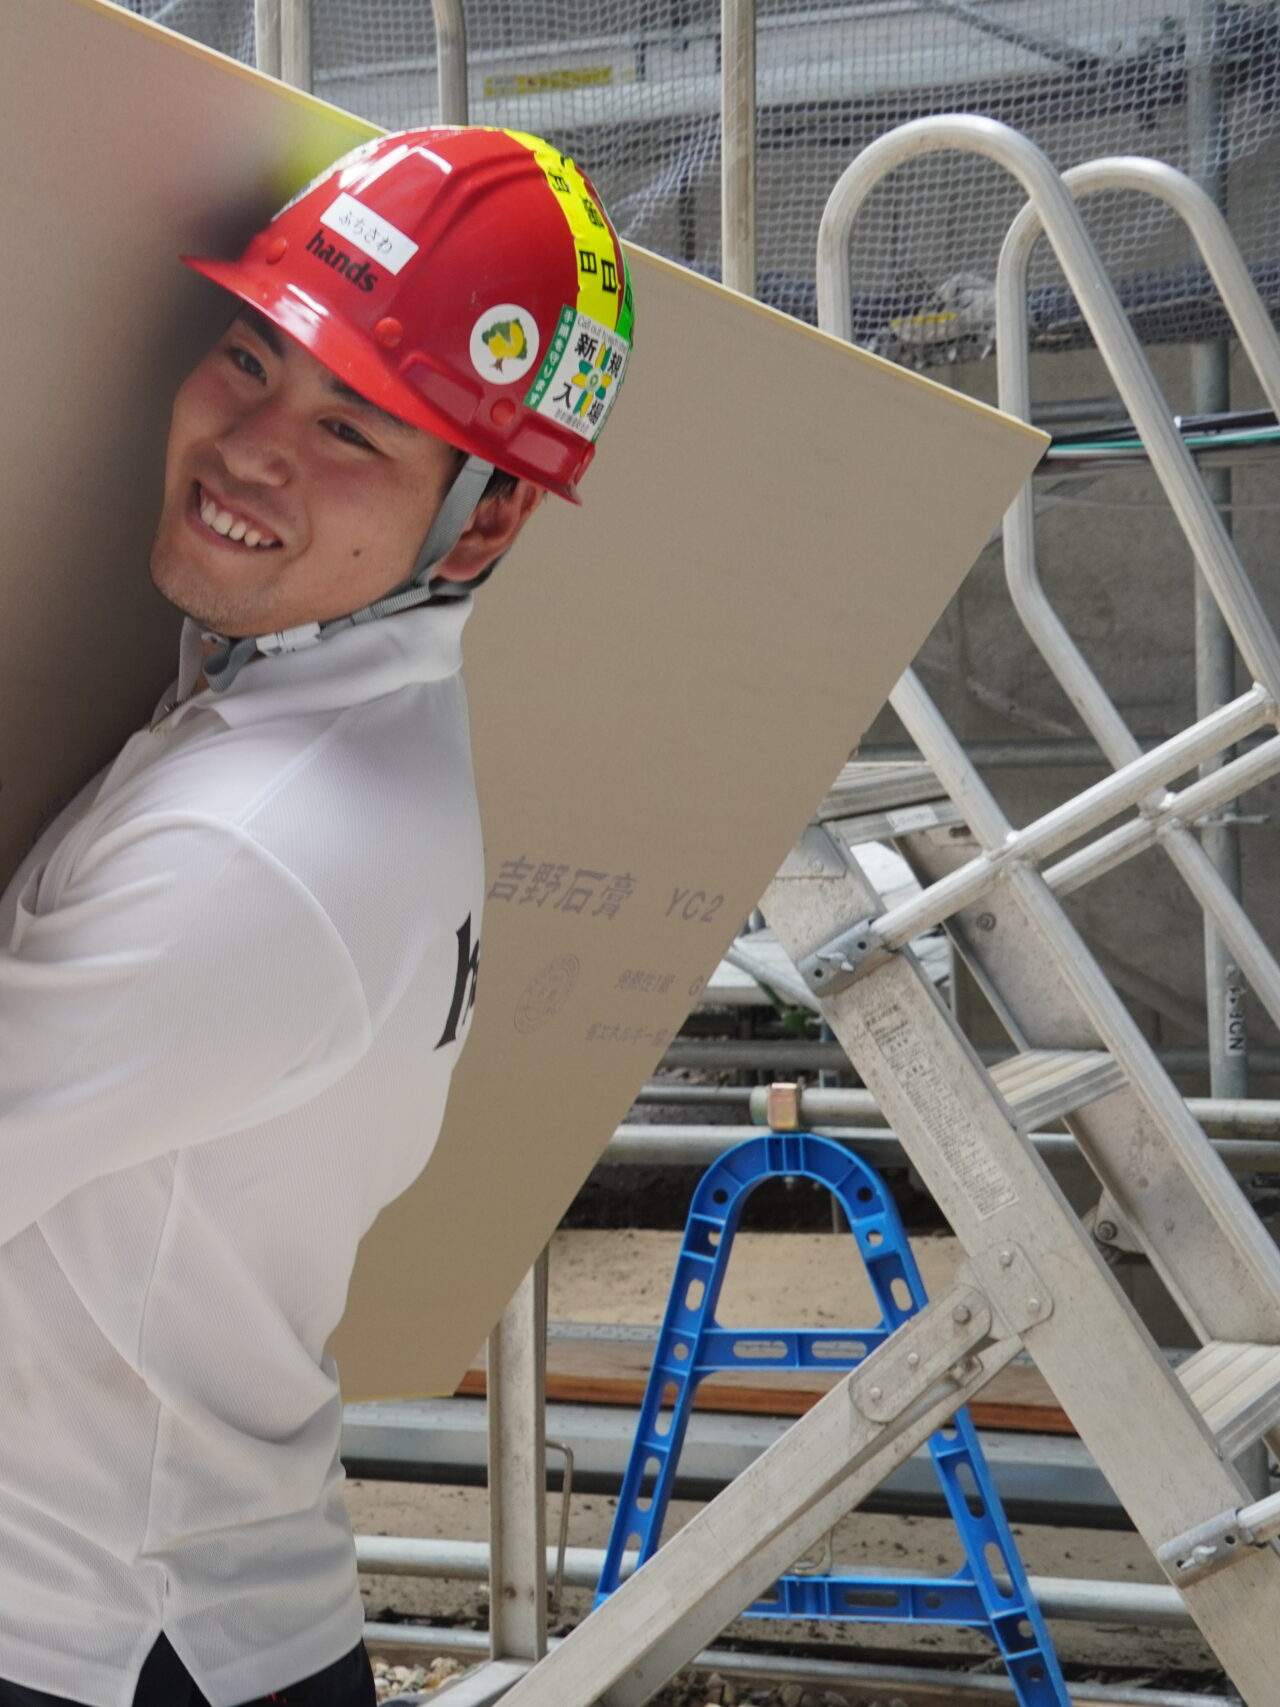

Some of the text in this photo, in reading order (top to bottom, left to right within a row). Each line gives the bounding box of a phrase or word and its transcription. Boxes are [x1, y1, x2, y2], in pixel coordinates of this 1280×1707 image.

[305, 228, 379, 293] hands
[487, 856, 725, 923] 吉野石膏 YC2
